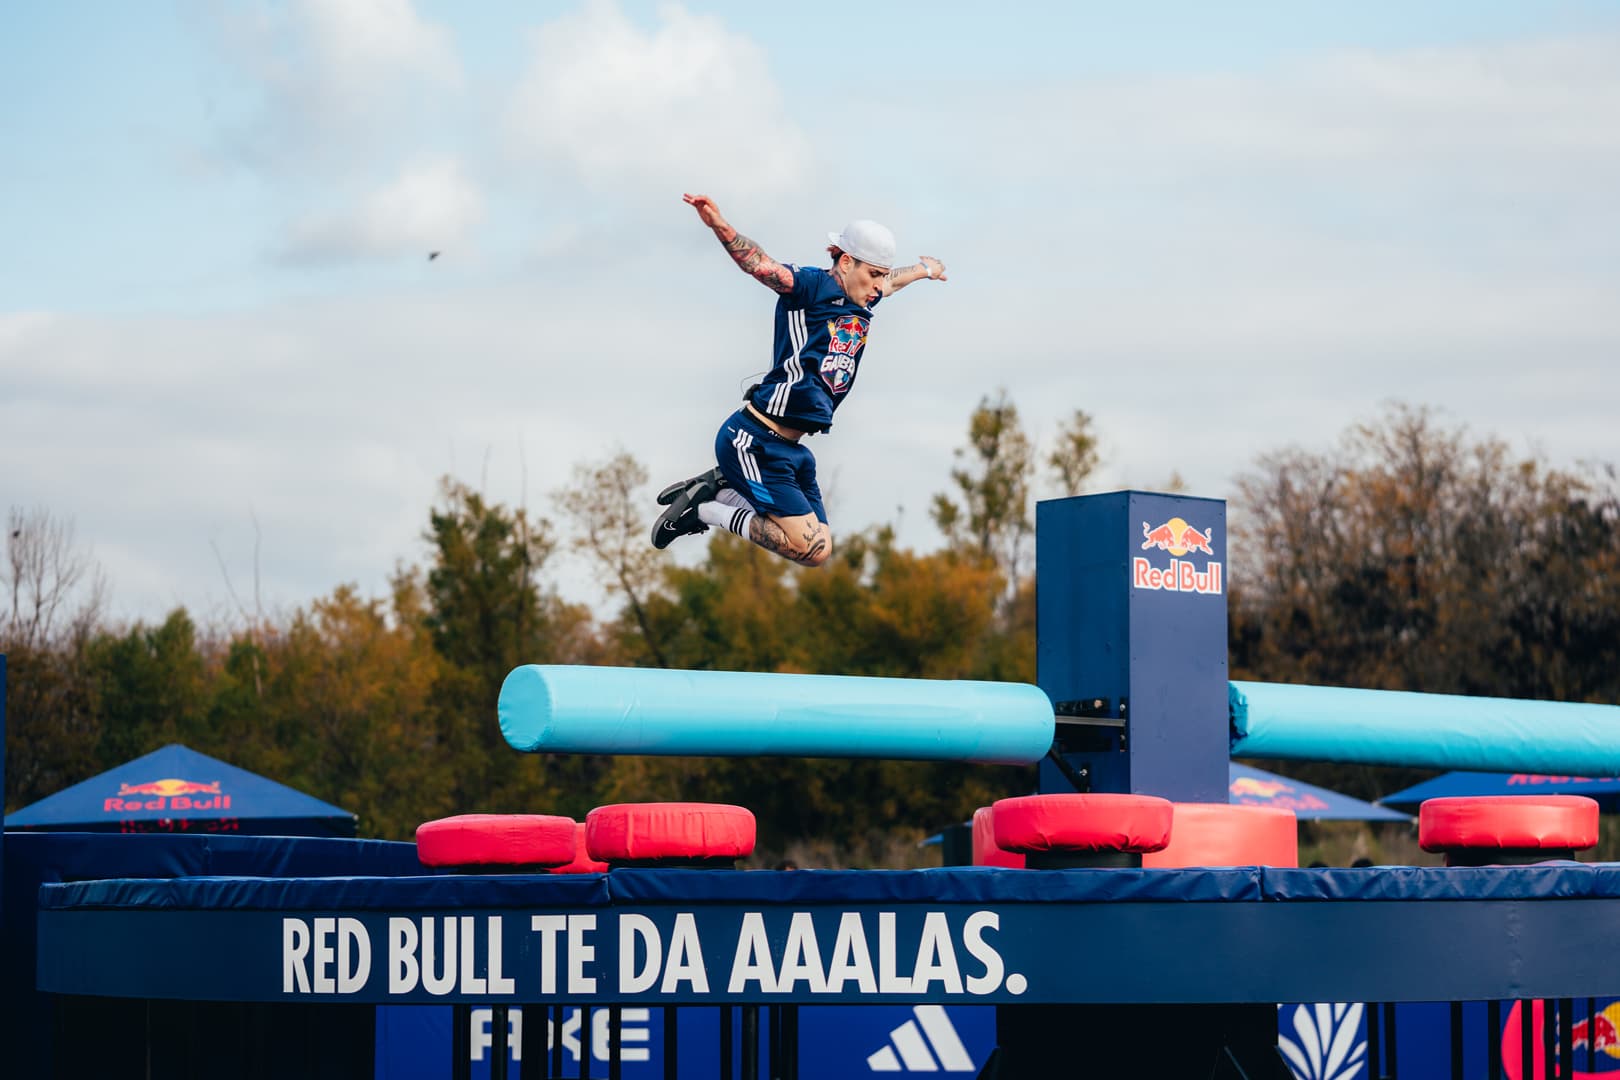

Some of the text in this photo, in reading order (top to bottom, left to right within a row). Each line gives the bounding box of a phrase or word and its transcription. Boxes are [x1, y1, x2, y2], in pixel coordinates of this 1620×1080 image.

[1133, 557, 1222, 594] Red Bull
[104, 795, 231, 812] Red Bull
[283, 910, 1028, 995] RED BULL TE DA AAALAS.
